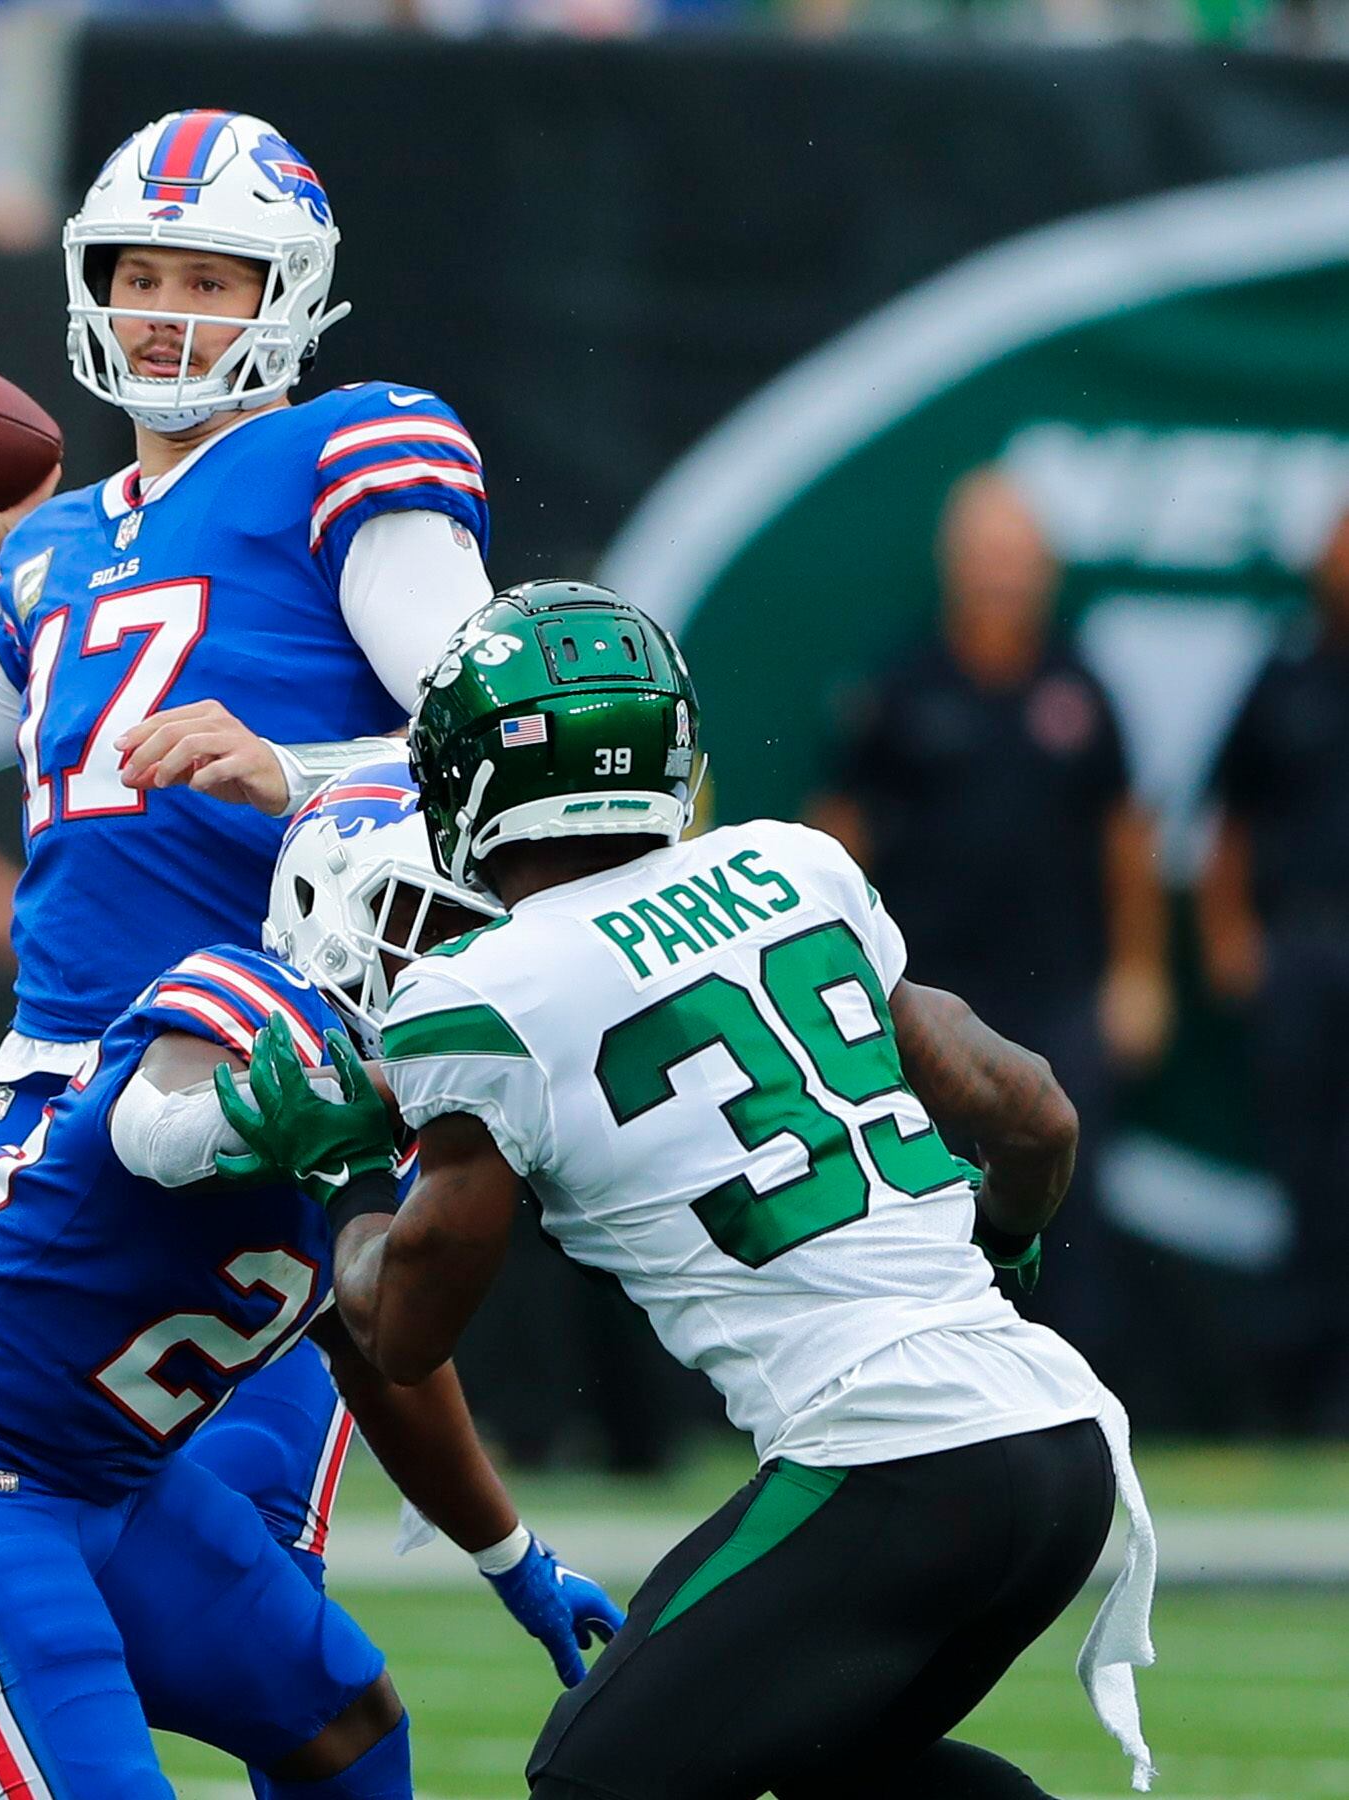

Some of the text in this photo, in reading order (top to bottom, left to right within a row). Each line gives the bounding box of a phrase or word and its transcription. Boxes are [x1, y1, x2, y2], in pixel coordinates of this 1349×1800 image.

[88, 557, 140, 589] BILLS
[16, 576, 211, 838] 17
[594, 747, 632, 776] 39
[591, 850, 800, 979] PARKS
[594, 918, 966, 1269] 39
